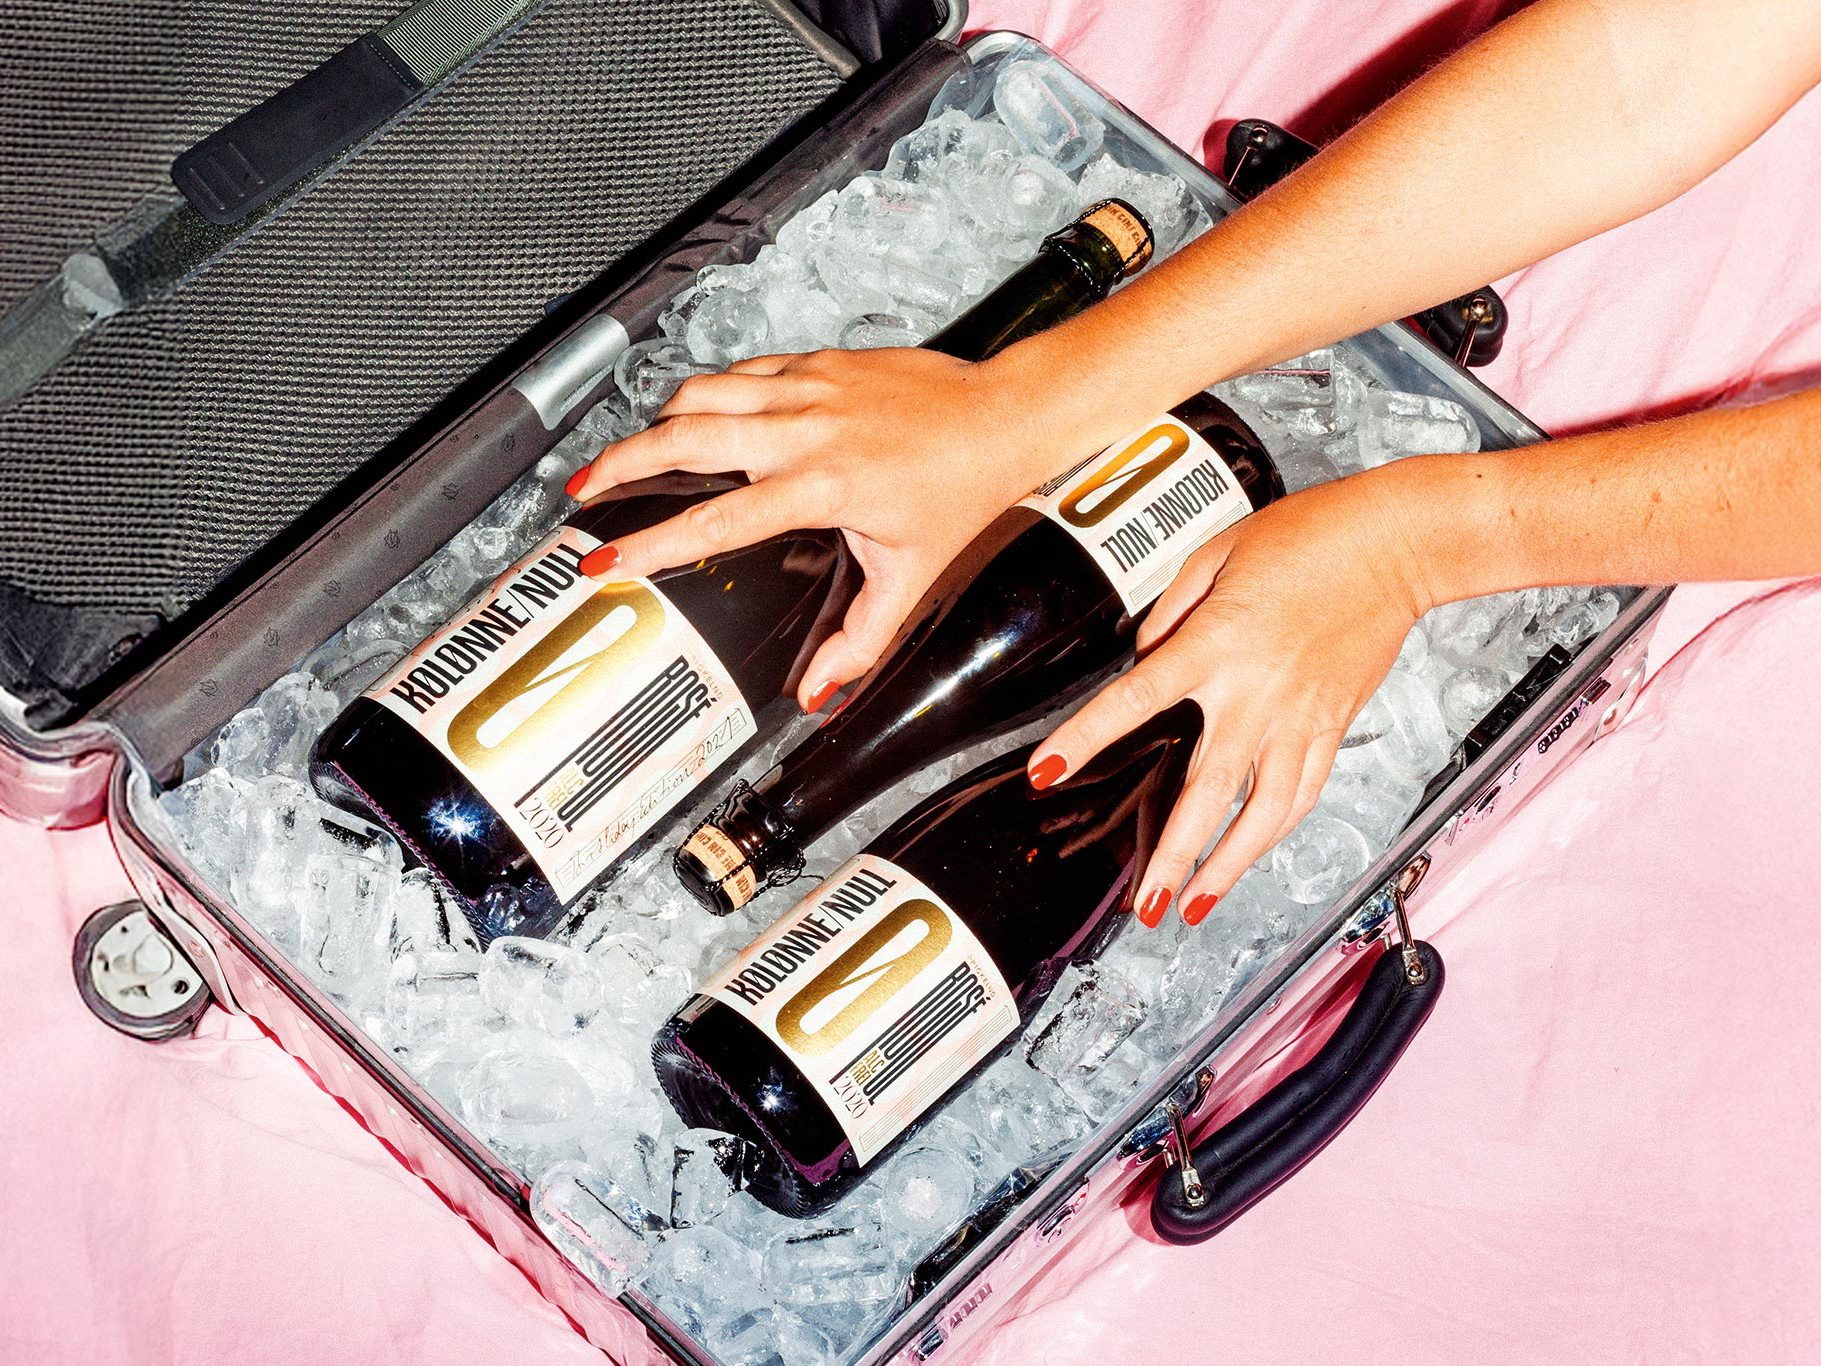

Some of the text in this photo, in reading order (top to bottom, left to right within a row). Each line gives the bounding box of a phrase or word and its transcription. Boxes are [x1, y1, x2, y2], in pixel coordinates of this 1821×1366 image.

[519, 798, 564, 848] 2020
[849, 1061, 872, 1086] FREI
[863, 1050, 885, 1074] ALC
[833, 1076, 868, 1119] 2020
